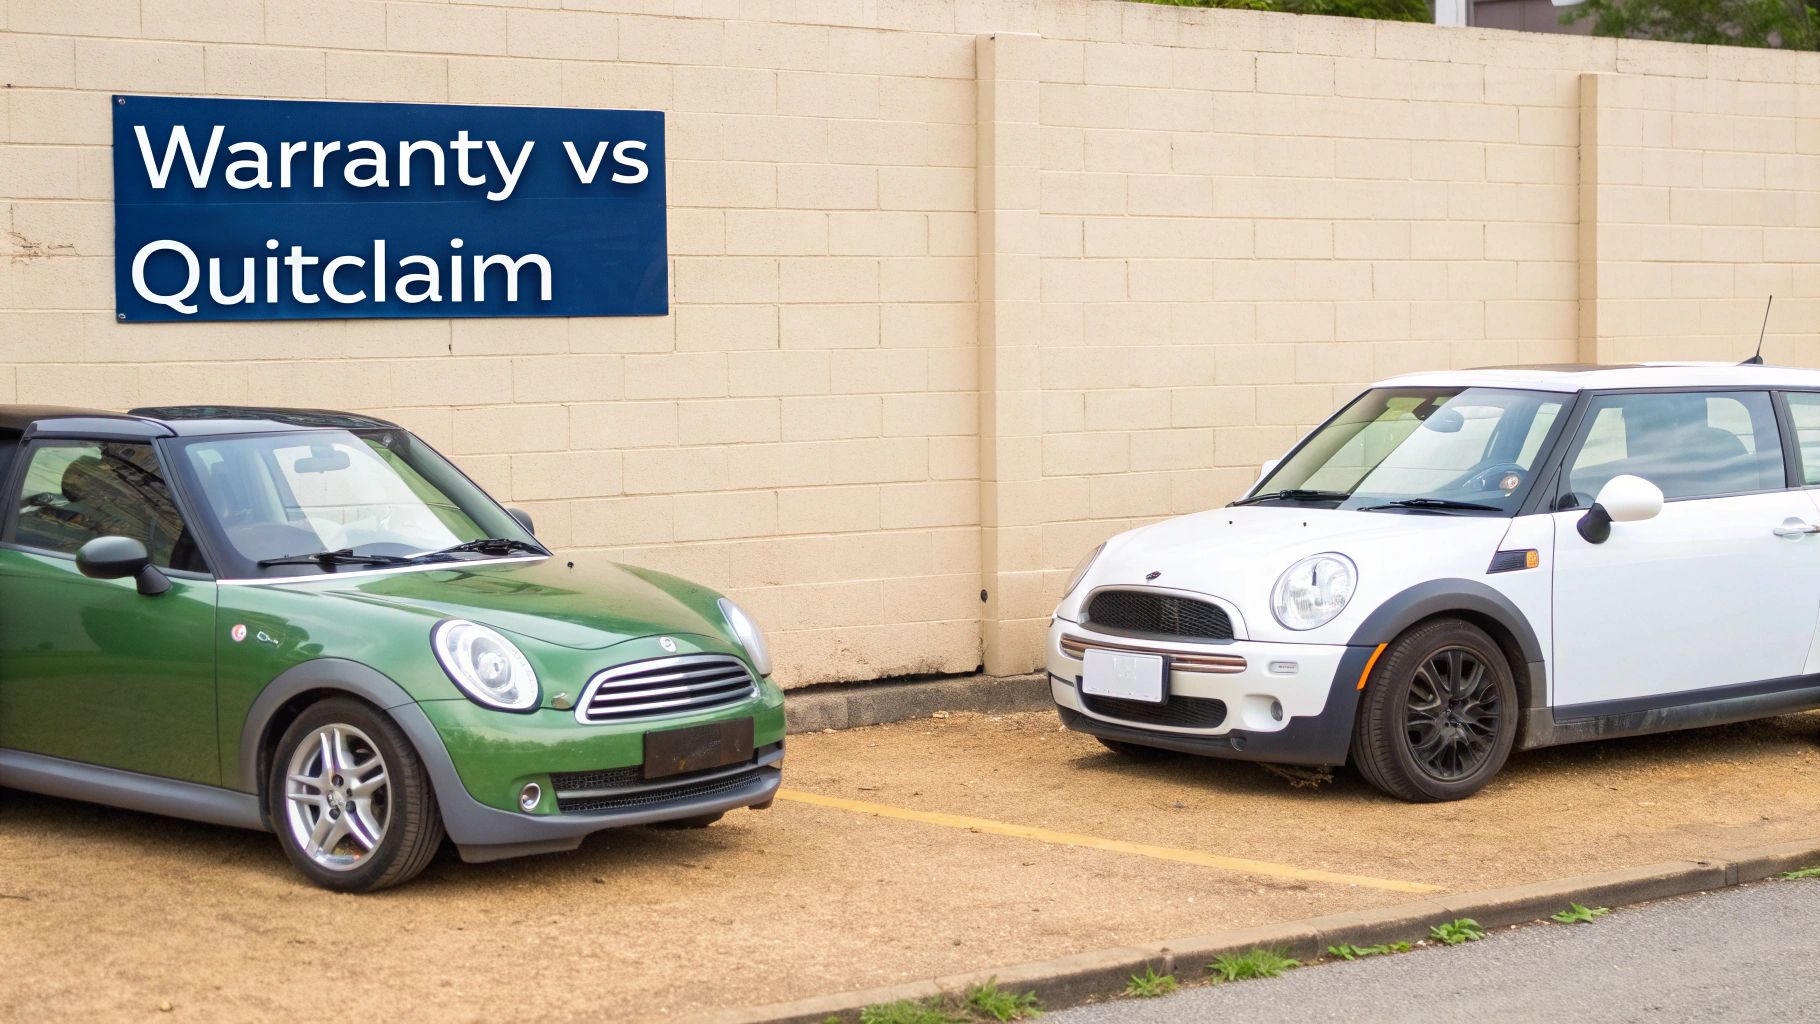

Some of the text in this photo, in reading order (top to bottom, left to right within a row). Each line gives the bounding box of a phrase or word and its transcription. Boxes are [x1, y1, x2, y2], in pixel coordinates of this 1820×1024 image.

[133, 125, 649, 202] Warranty vs
[131, 238, 553, 315] Quitclaim
